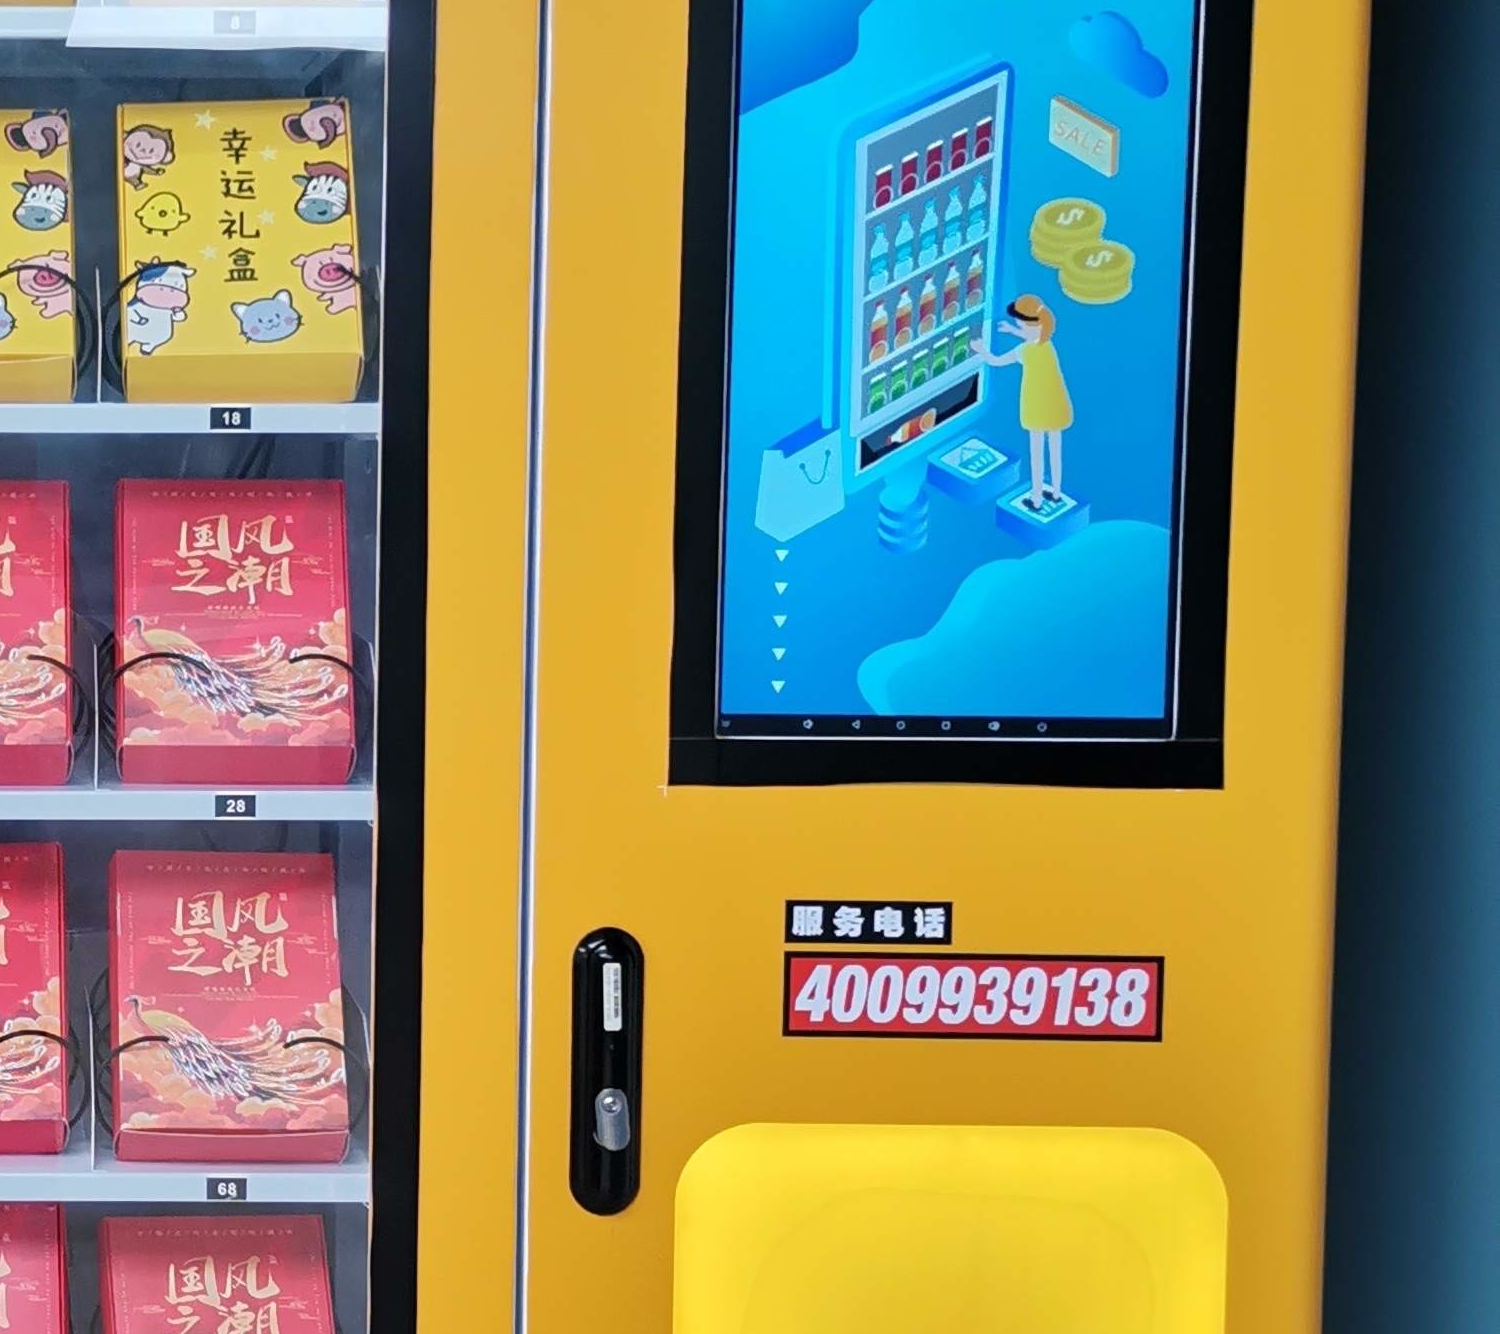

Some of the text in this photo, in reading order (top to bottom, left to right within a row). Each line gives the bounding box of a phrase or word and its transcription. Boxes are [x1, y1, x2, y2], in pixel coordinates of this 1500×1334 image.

[1054, 122, 1106, 156] SALE
[218, 127, 260, 283] 幸运礼盒
[222, 412, 241, 425] 18
[175, 514, 295, 559] 国风
[170, 557, 292, 604] 之潮
[226, 799, 246, 813] 28
[170, 891, 289, 937] 国风
[791, 906, 945, 938] 服务电话
[168, 936, 288, 985] 之潮
[795, 964, 1150, 1027] 4009939138
[217, 1182, 237, 1196] 68
[165, 1254, 282, 1307] 国风
